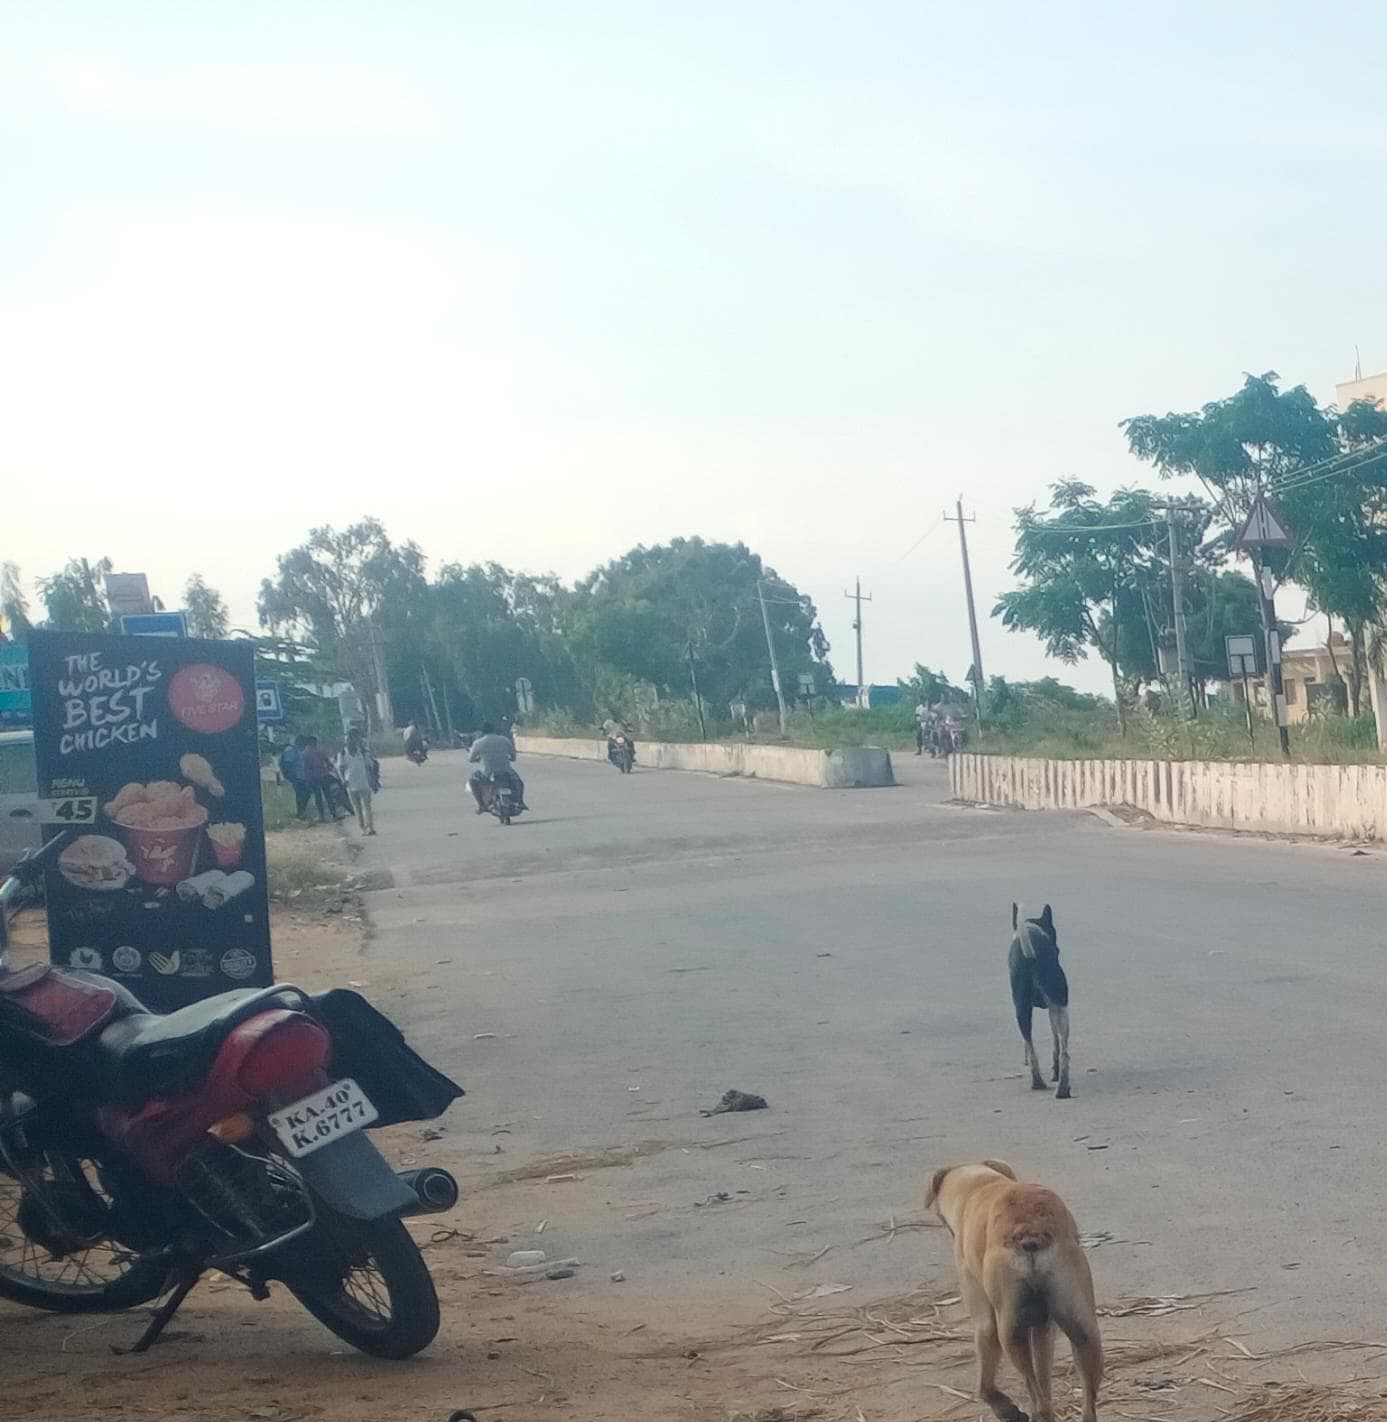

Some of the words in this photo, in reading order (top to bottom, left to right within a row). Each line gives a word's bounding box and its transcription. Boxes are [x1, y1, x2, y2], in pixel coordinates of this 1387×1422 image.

[58, 660, 162, 697] WORLD'S
[64, 652, 102, 675] THE
[63, 685, 155, 729] BEST
[61, 719, 157, 755] CHICKEN
